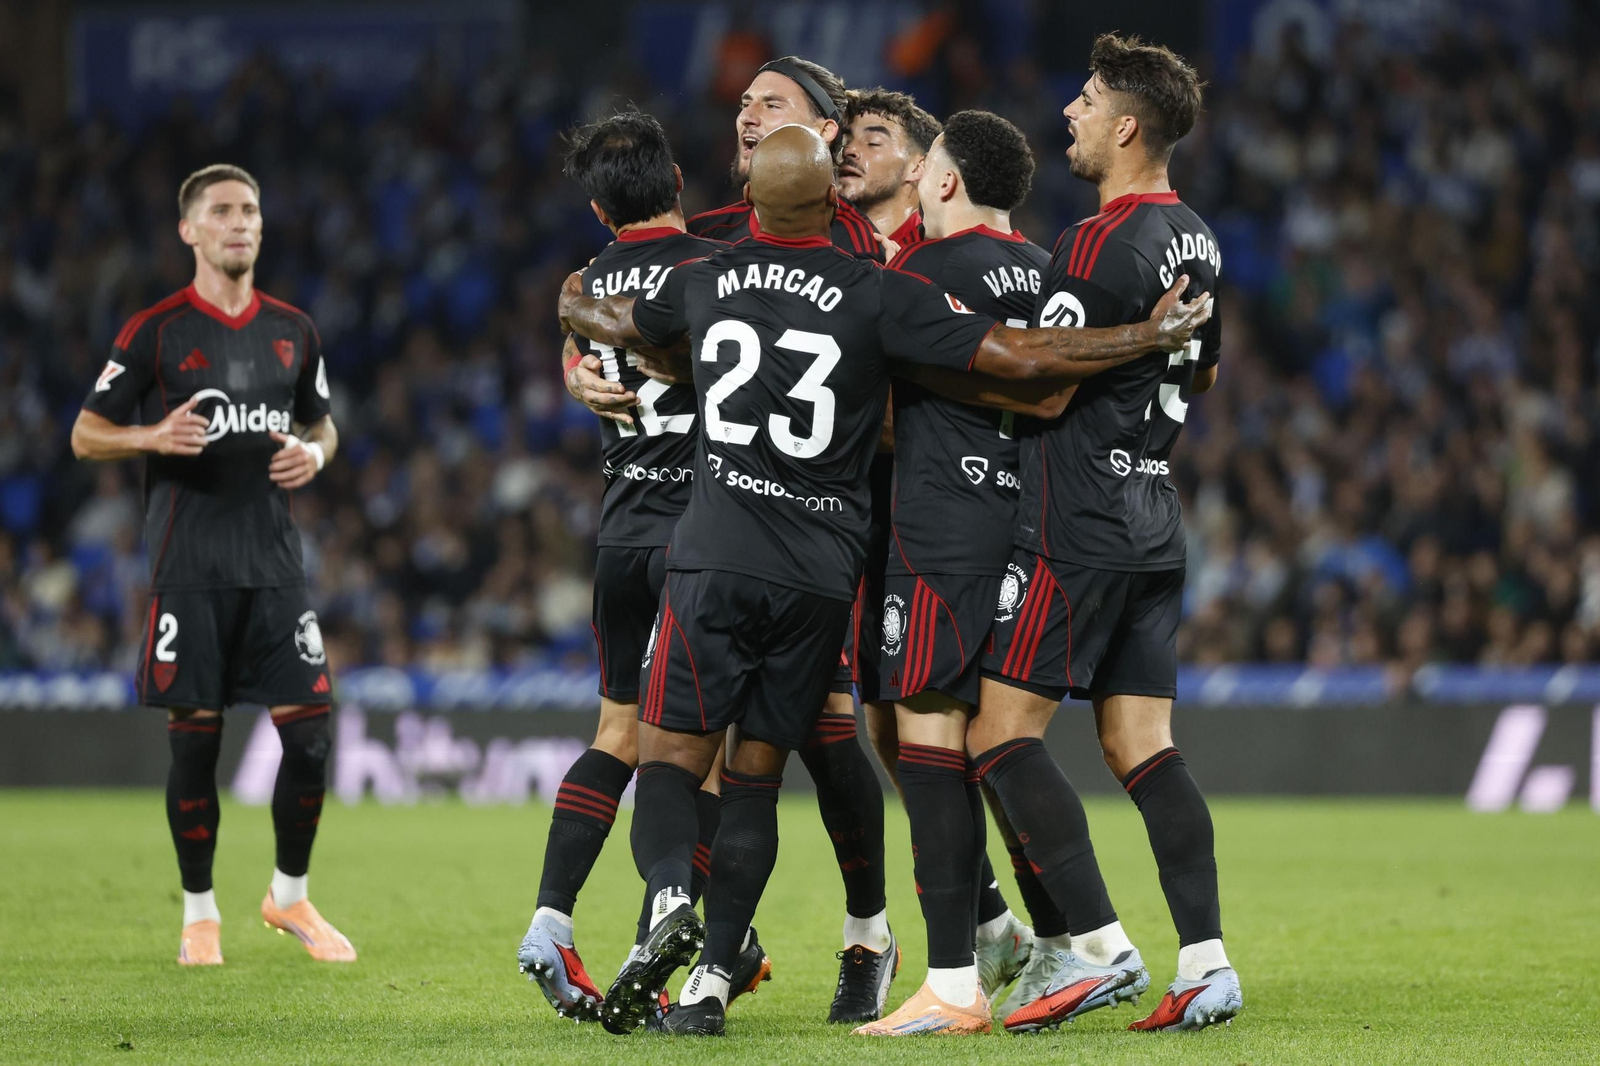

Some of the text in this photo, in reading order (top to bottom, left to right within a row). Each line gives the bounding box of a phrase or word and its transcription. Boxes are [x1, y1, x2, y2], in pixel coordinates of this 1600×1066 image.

[717, 263, 843, 312] MARCAO
[700, 319, 842, 459] 23
[206, 403, 291, 433] Midea
[155, 612, 178, 662] 2
